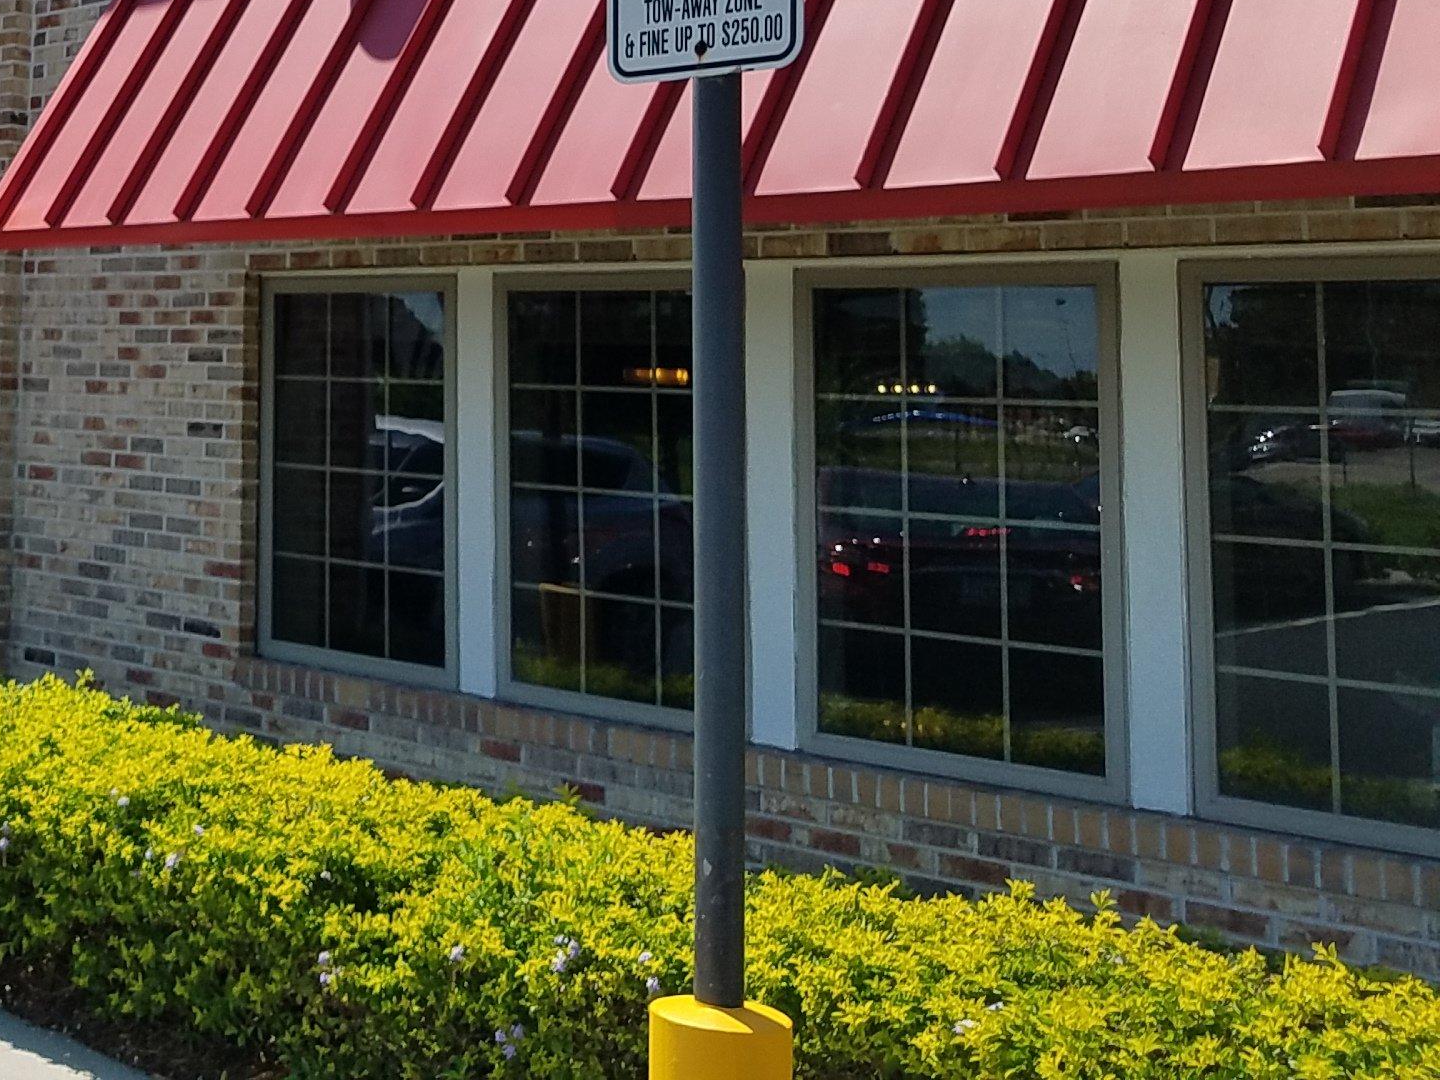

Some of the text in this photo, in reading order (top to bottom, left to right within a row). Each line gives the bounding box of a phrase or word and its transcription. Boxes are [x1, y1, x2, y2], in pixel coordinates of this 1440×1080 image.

[625, 13, 783, 58] & FINE UP TO $250.00
